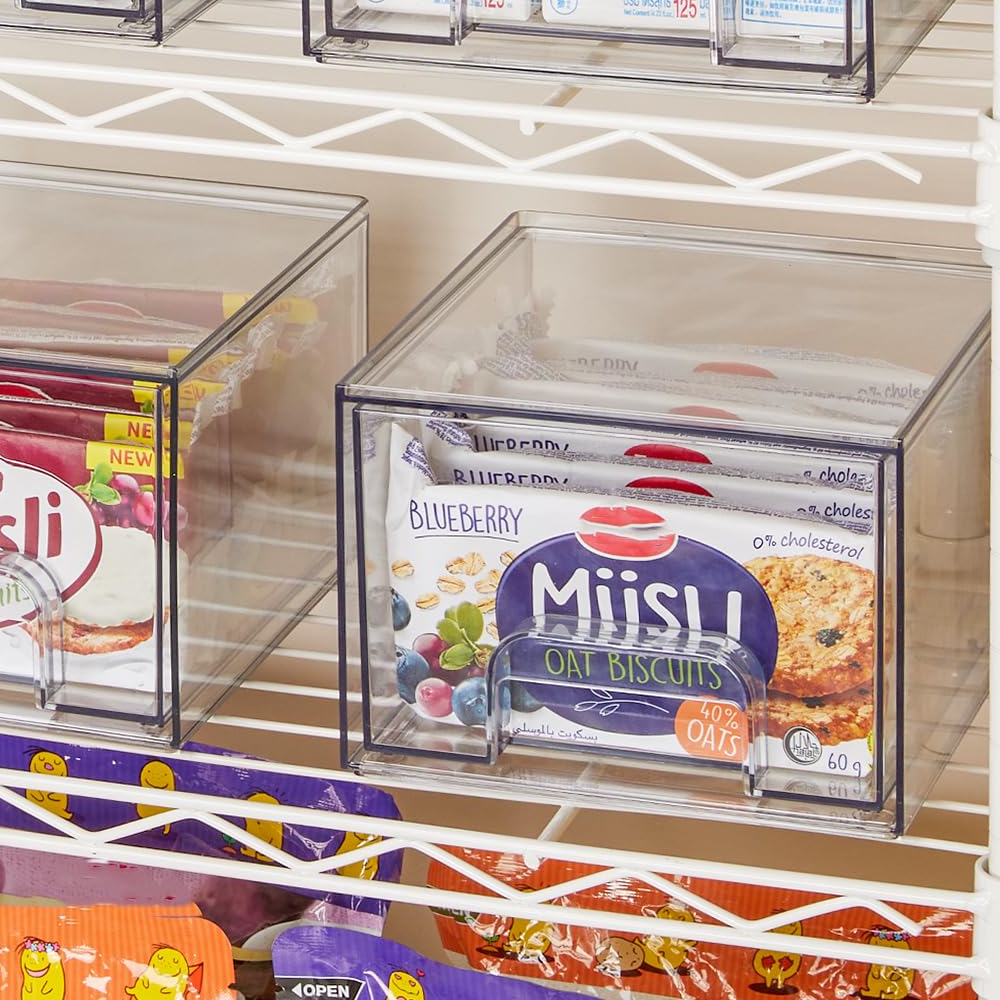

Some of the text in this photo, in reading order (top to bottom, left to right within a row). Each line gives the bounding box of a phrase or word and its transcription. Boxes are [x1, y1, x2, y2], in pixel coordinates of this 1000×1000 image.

[127, 420, 153, 438] NE
[109, 448, 153, 468] NEW
[410, 499, 523, 536] BLUEBERRY
[753, 532, 865, 560] 0% cholesterol
[545, 648, 723, 690] OAT BISCUITS
[701, 701, 739, 730] 40%
[687, 718, 741, 758] OATS
[827, 753, 861, 778] 60 g
[302, 984, 350, 998] OPEN
